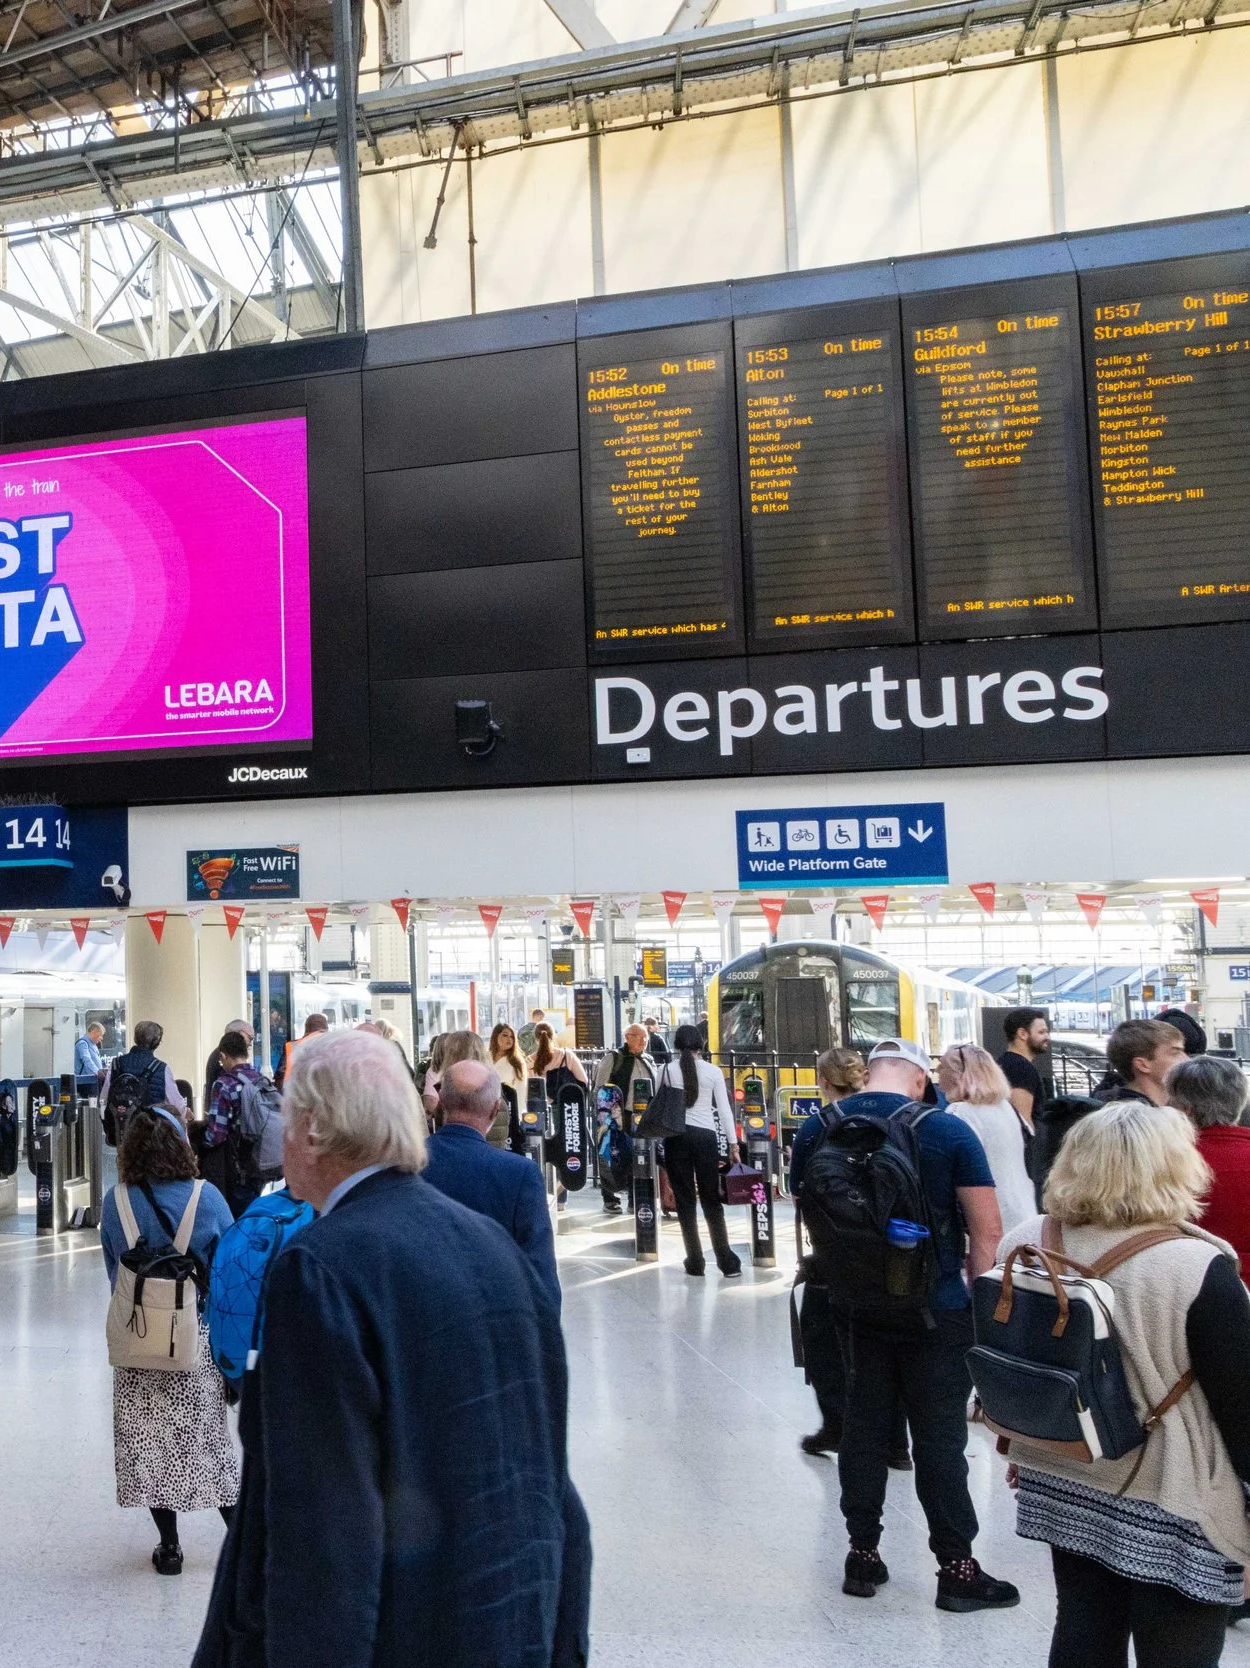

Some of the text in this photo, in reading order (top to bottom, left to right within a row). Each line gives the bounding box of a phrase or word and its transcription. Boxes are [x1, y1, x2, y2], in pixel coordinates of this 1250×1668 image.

[1096, 292, 1249, 321] 15:57 On time
[916, 316, 1059, 342] 15:54 On time
[1094, 311, 1228, 340] Strawberry Hill
[748, 338, 882, 364] 15:53 On time
[914, 341, 986, 361] Guildford
[1096, 352, 1152, 367] Calling at:
[589, 359, 716, 383] 15:52 On time
[746, 368, 784, 382] Alton
[915, 362, 971, 374] via Epsom
[940, 367, 1037, 383] Please note, some
[1097, 366, 1144, 378] Vauxhall
[1097, 374, 1193, 391] Clapham Junction
[588, 382, 666, 401] Addlestone
[1098, 391, 1153, 404] Earlsfield
[606, 399, 656, 411] Hounslow
[748, 394, 797, 406] Calling at:
[748, 408, 789, 418] Surbiton
[1099, 404, 1152, 417] Wimbledon
[627, 420, 679, 432] passes and
[748, 416, 813, 430] West Byfleet
[1099, 415, 1168, 430] Raynes Park
[604, 428, 702, 446] contactless payment
[749, 432, 780, 442] Woking
[1100, 429, 1162, 442] New Malden
[956, 442, 1027, 456] need further
[1101, 443, 1148, 455] Norbiton
[626, 454, 684, 468] used beyond
[750, 455, 792, 465] Ash Vale
[964, 455, 1021, 468] assistance
[1102, 456, 1149, 468] Kingston
[750, 466, 798, 478] Aldershot
[1102, 466, 1176, 481] Hampton Wick
[4, 482, 25, 497] the
[32, 477, 60, 494] train
[611, 477, 699, 492] travelling further
[751, 479, 791, 489] Farnham
[1103, 480, 1164, 493] Teddington
[751, 492, 788, 501] Bentley
[1104, 489, 1204, 506] & Strawberry Hill
[752, 503, 789, 513] & Alton
[638, 526, 676, 537] journey.
[165, 679, 274, 708] LEBARA
[212, 708, 239, 717] mobile
[240, 706, 274, 715] network
[594, 665, 1110, 755] Departures
[228, 767, 308, 782] JCDecaux
[6, 818, 46, 849] 14
[55, 819, 70, 850] 14
[260, 856, 296, 871] WiFi
[749, 856, 887, 872] Wide Platform Gate
[708, 963, 721, 972] 14
[853, 970, 889, 979] 450037
[1231, 968, 1246, 977] 15
[726, 972, 759, 980] 450037
[564, 1103, 573, 1152] THIRSTY
[571, 1102, 580, 1152] FOR MORE
[757, 1203, 769, 1241] PEPS
